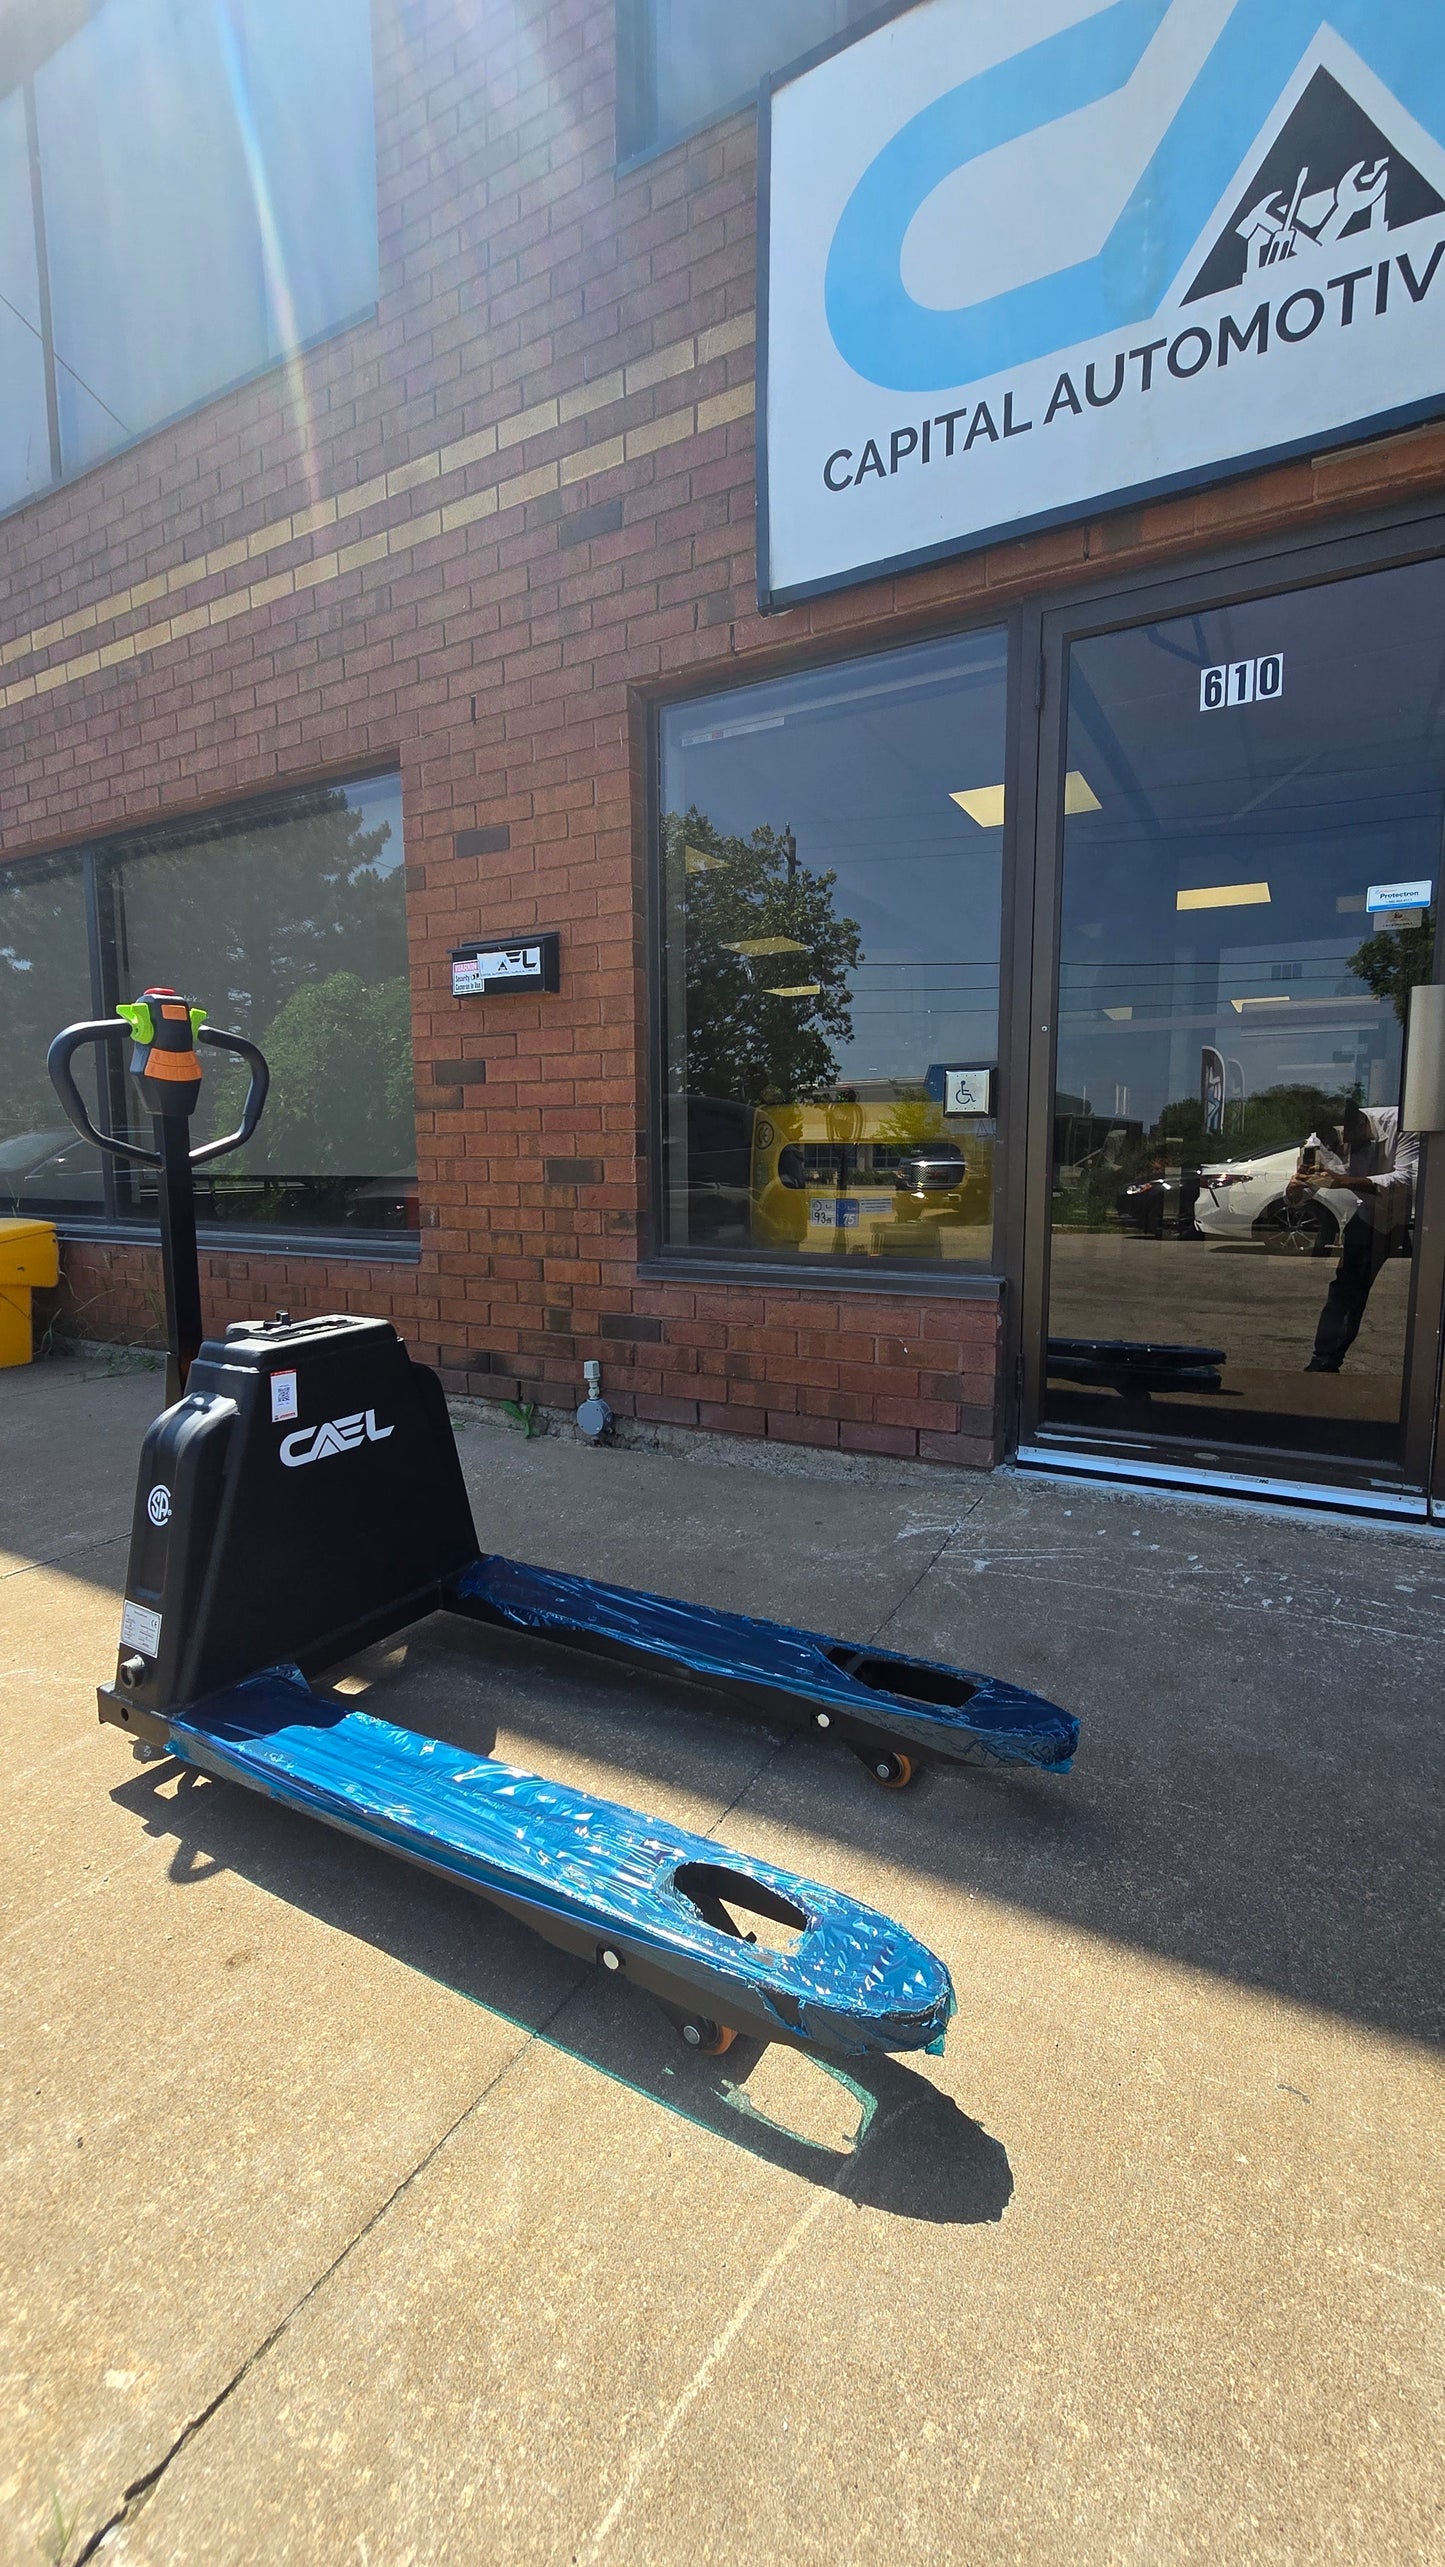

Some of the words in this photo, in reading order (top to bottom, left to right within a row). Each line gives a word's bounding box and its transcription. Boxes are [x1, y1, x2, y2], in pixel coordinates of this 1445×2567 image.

[822, 391, 1033, 492] CAPITAL
[1203, 656, 1280, 708] 610
[1379, 891, 1419, 899] Protectron
[456, 963, 478, 972] WARNIN
[279, 1408, 395, 1468] CAEL
